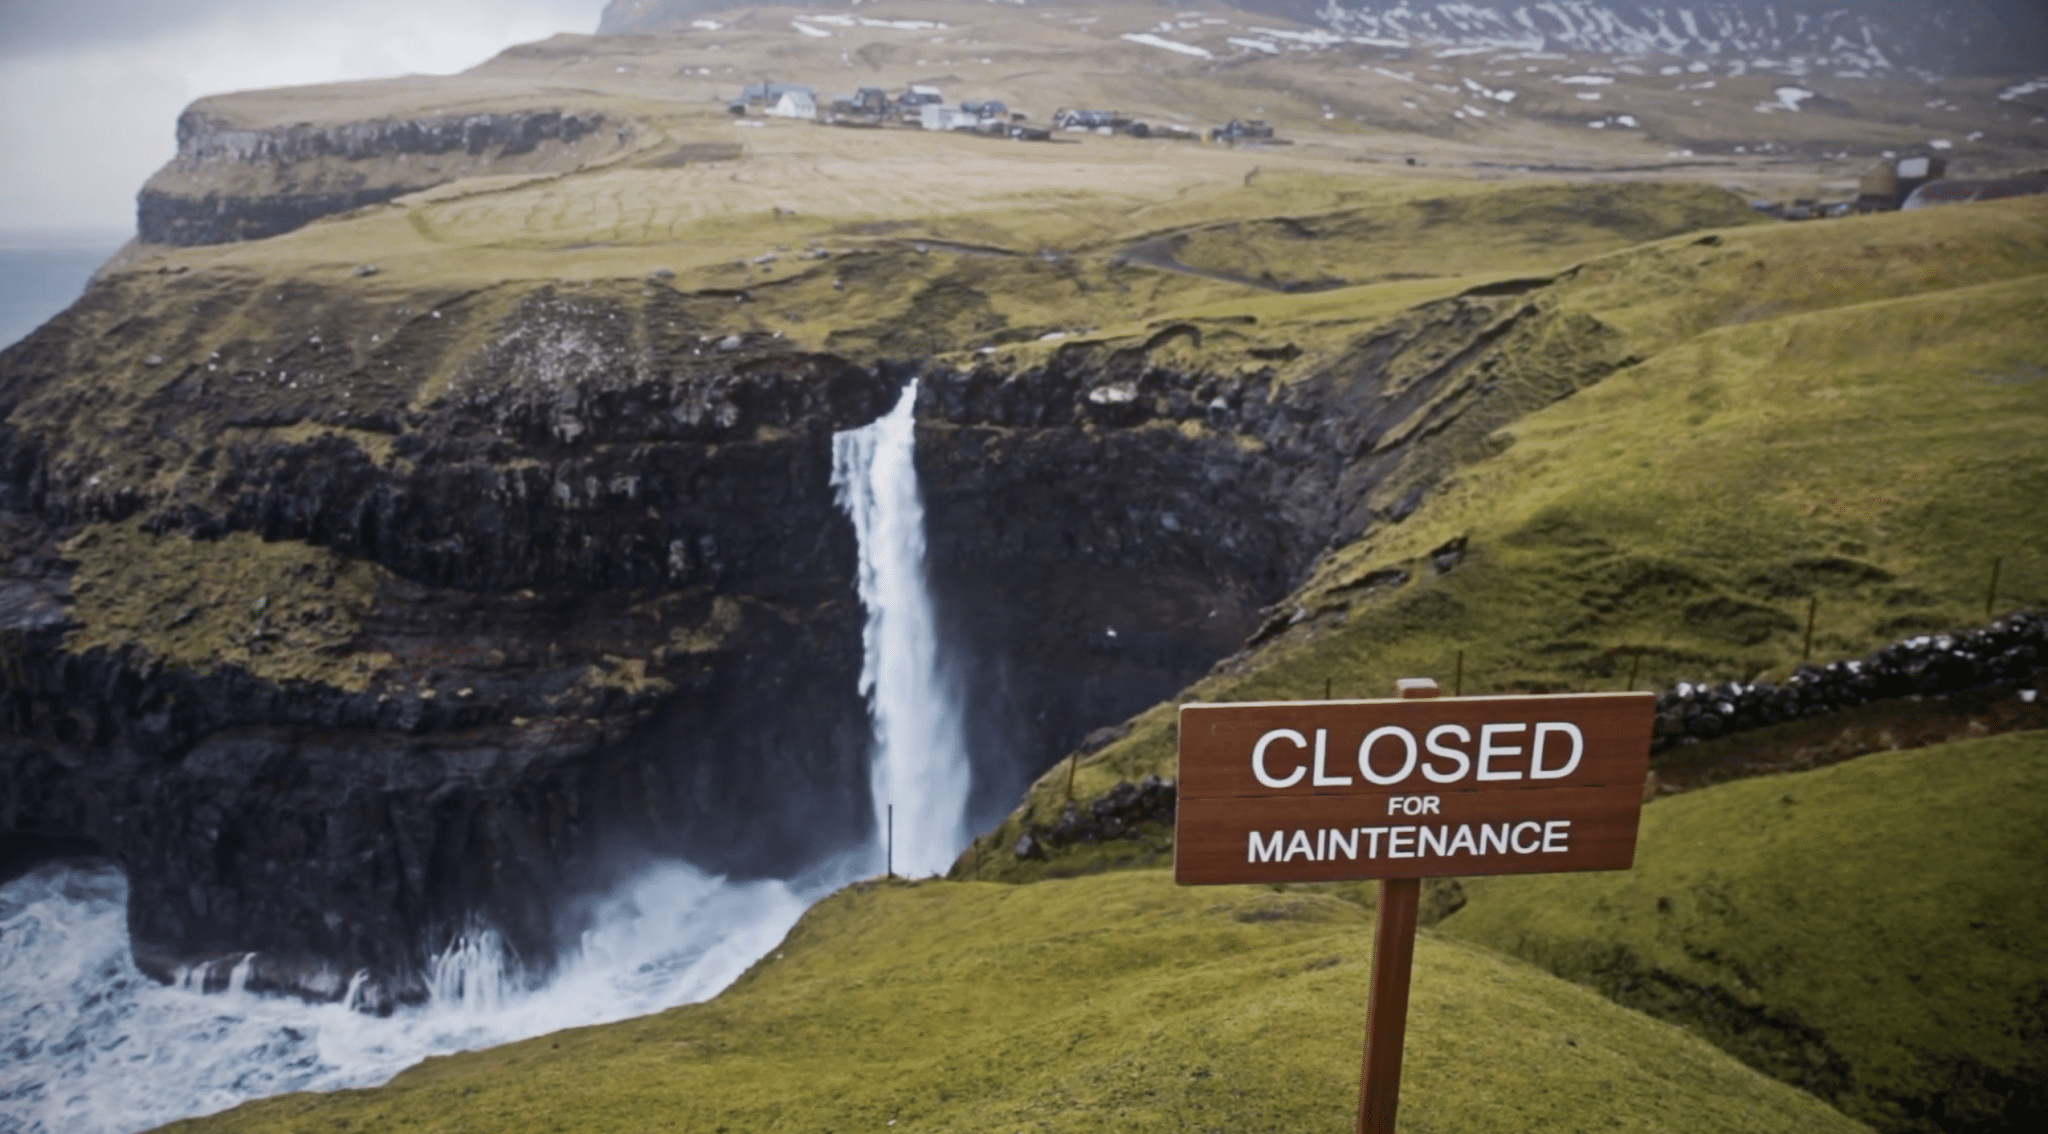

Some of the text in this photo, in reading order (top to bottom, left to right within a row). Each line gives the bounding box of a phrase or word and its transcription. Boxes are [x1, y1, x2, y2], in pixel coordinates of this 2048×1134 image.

[1252, 722, 1583, 788] CLOSED
[1388, 796, 1440, 816] FOR
[1247, 820, 1571, 863] MAINTENANCE
